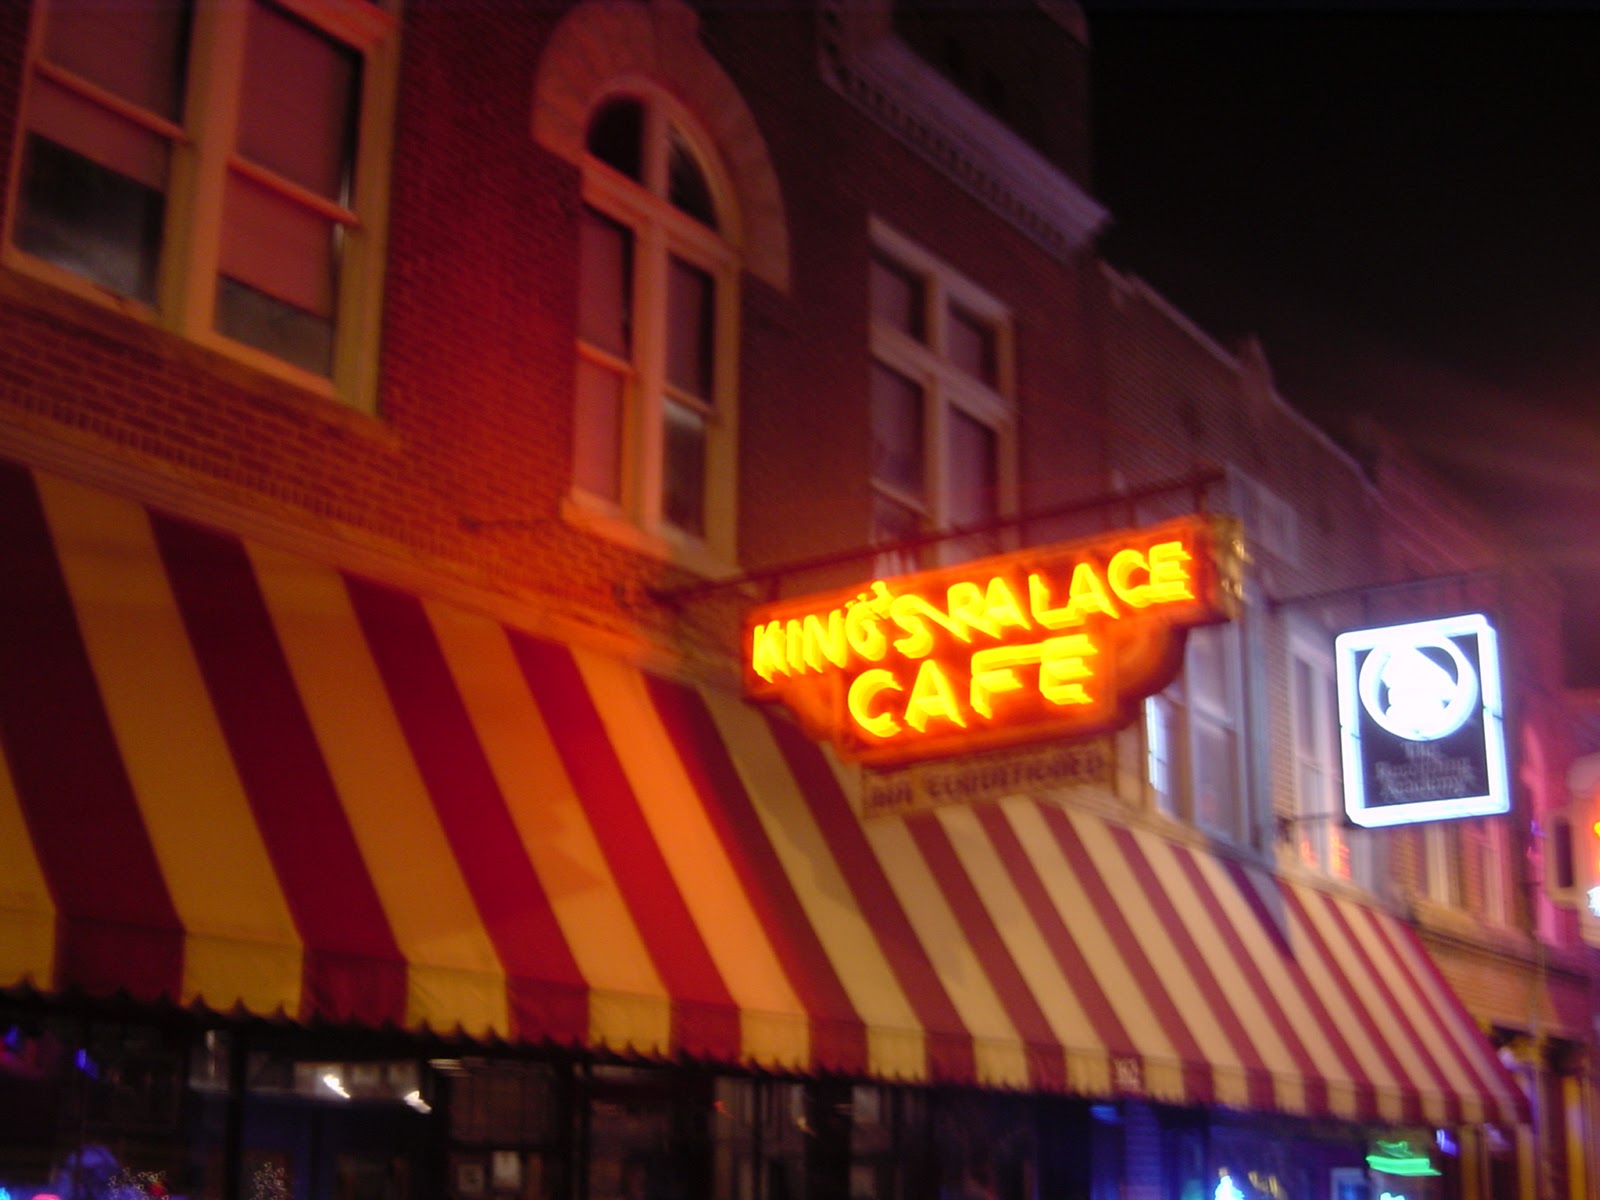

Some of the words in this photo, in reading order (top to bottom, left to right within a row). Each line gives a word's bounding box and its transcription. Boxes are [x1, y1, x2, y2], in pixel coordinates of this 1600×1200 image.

[752, 580, 934, 683] KING'S
[946, 540, 1196, 641] PALACE
[847, 633, 1100, 738] CAFE
